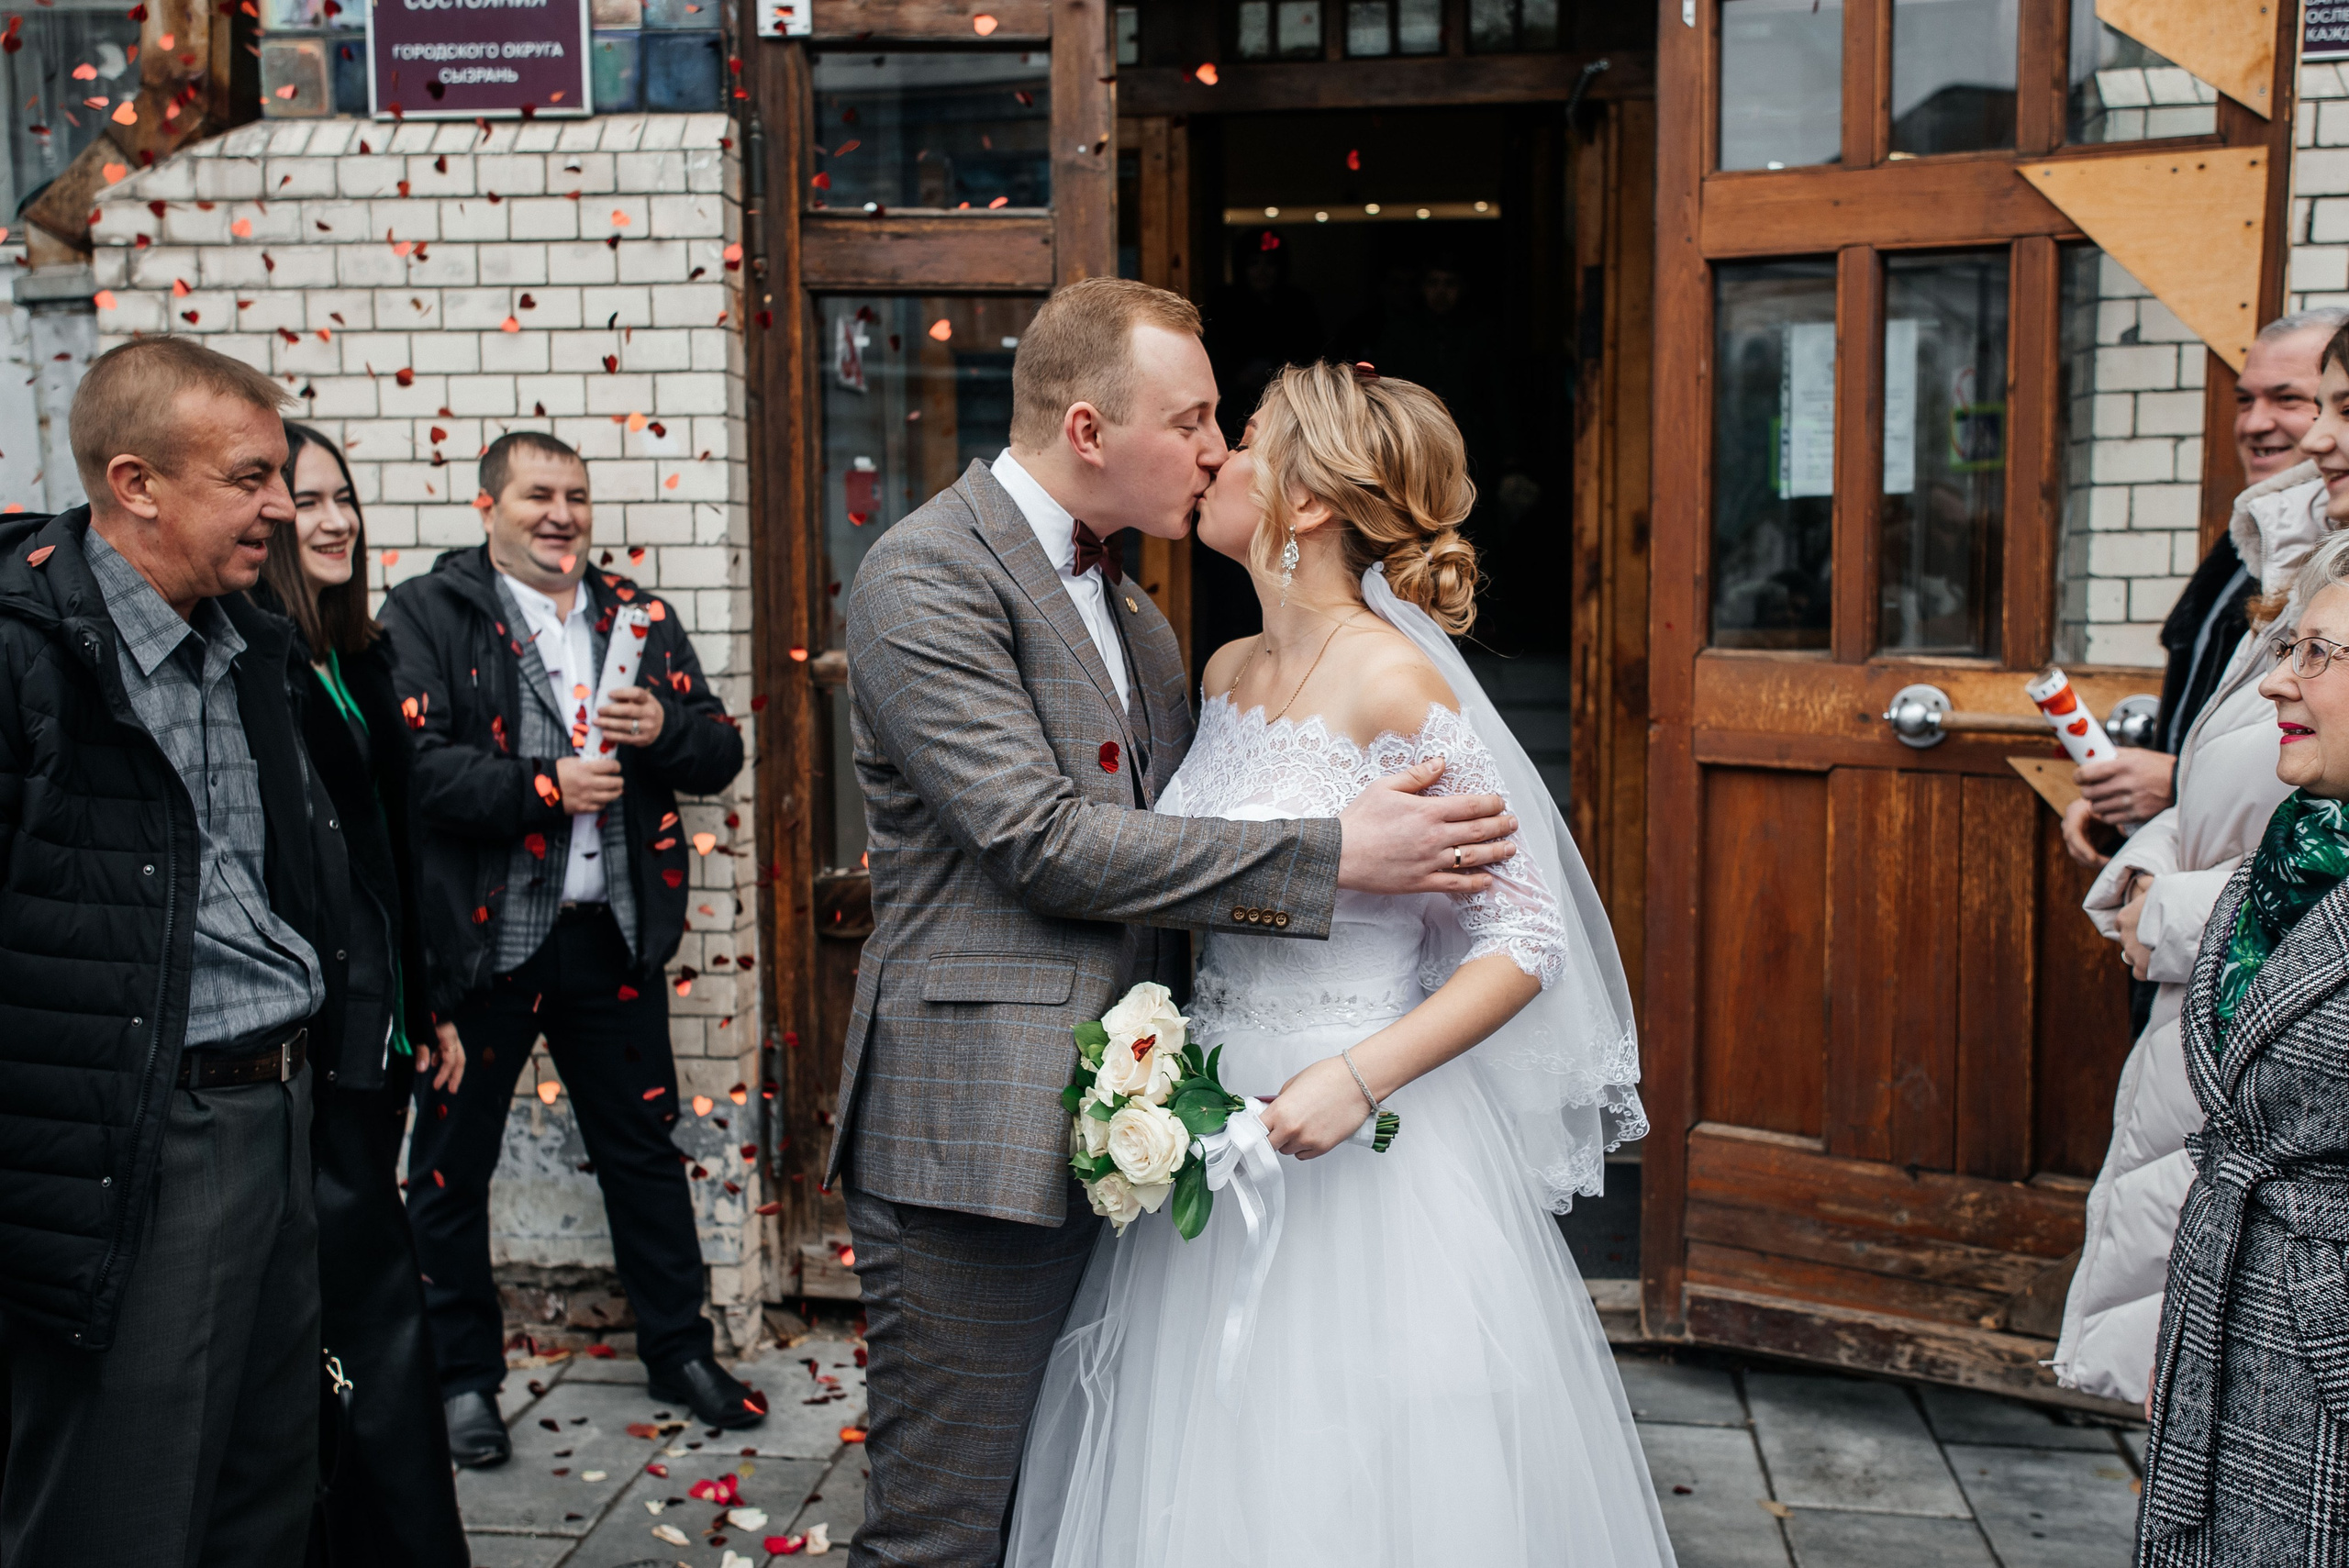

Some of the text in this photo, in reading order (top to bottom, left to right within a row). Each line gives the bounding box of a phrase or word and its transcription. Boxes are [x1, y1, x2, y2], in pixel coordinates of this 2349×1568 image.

[392, 41, 564, 61] ГОРОДСКОГО ОКРУГА
[438, 66, 519, 83] СЫЗРАНЬ
